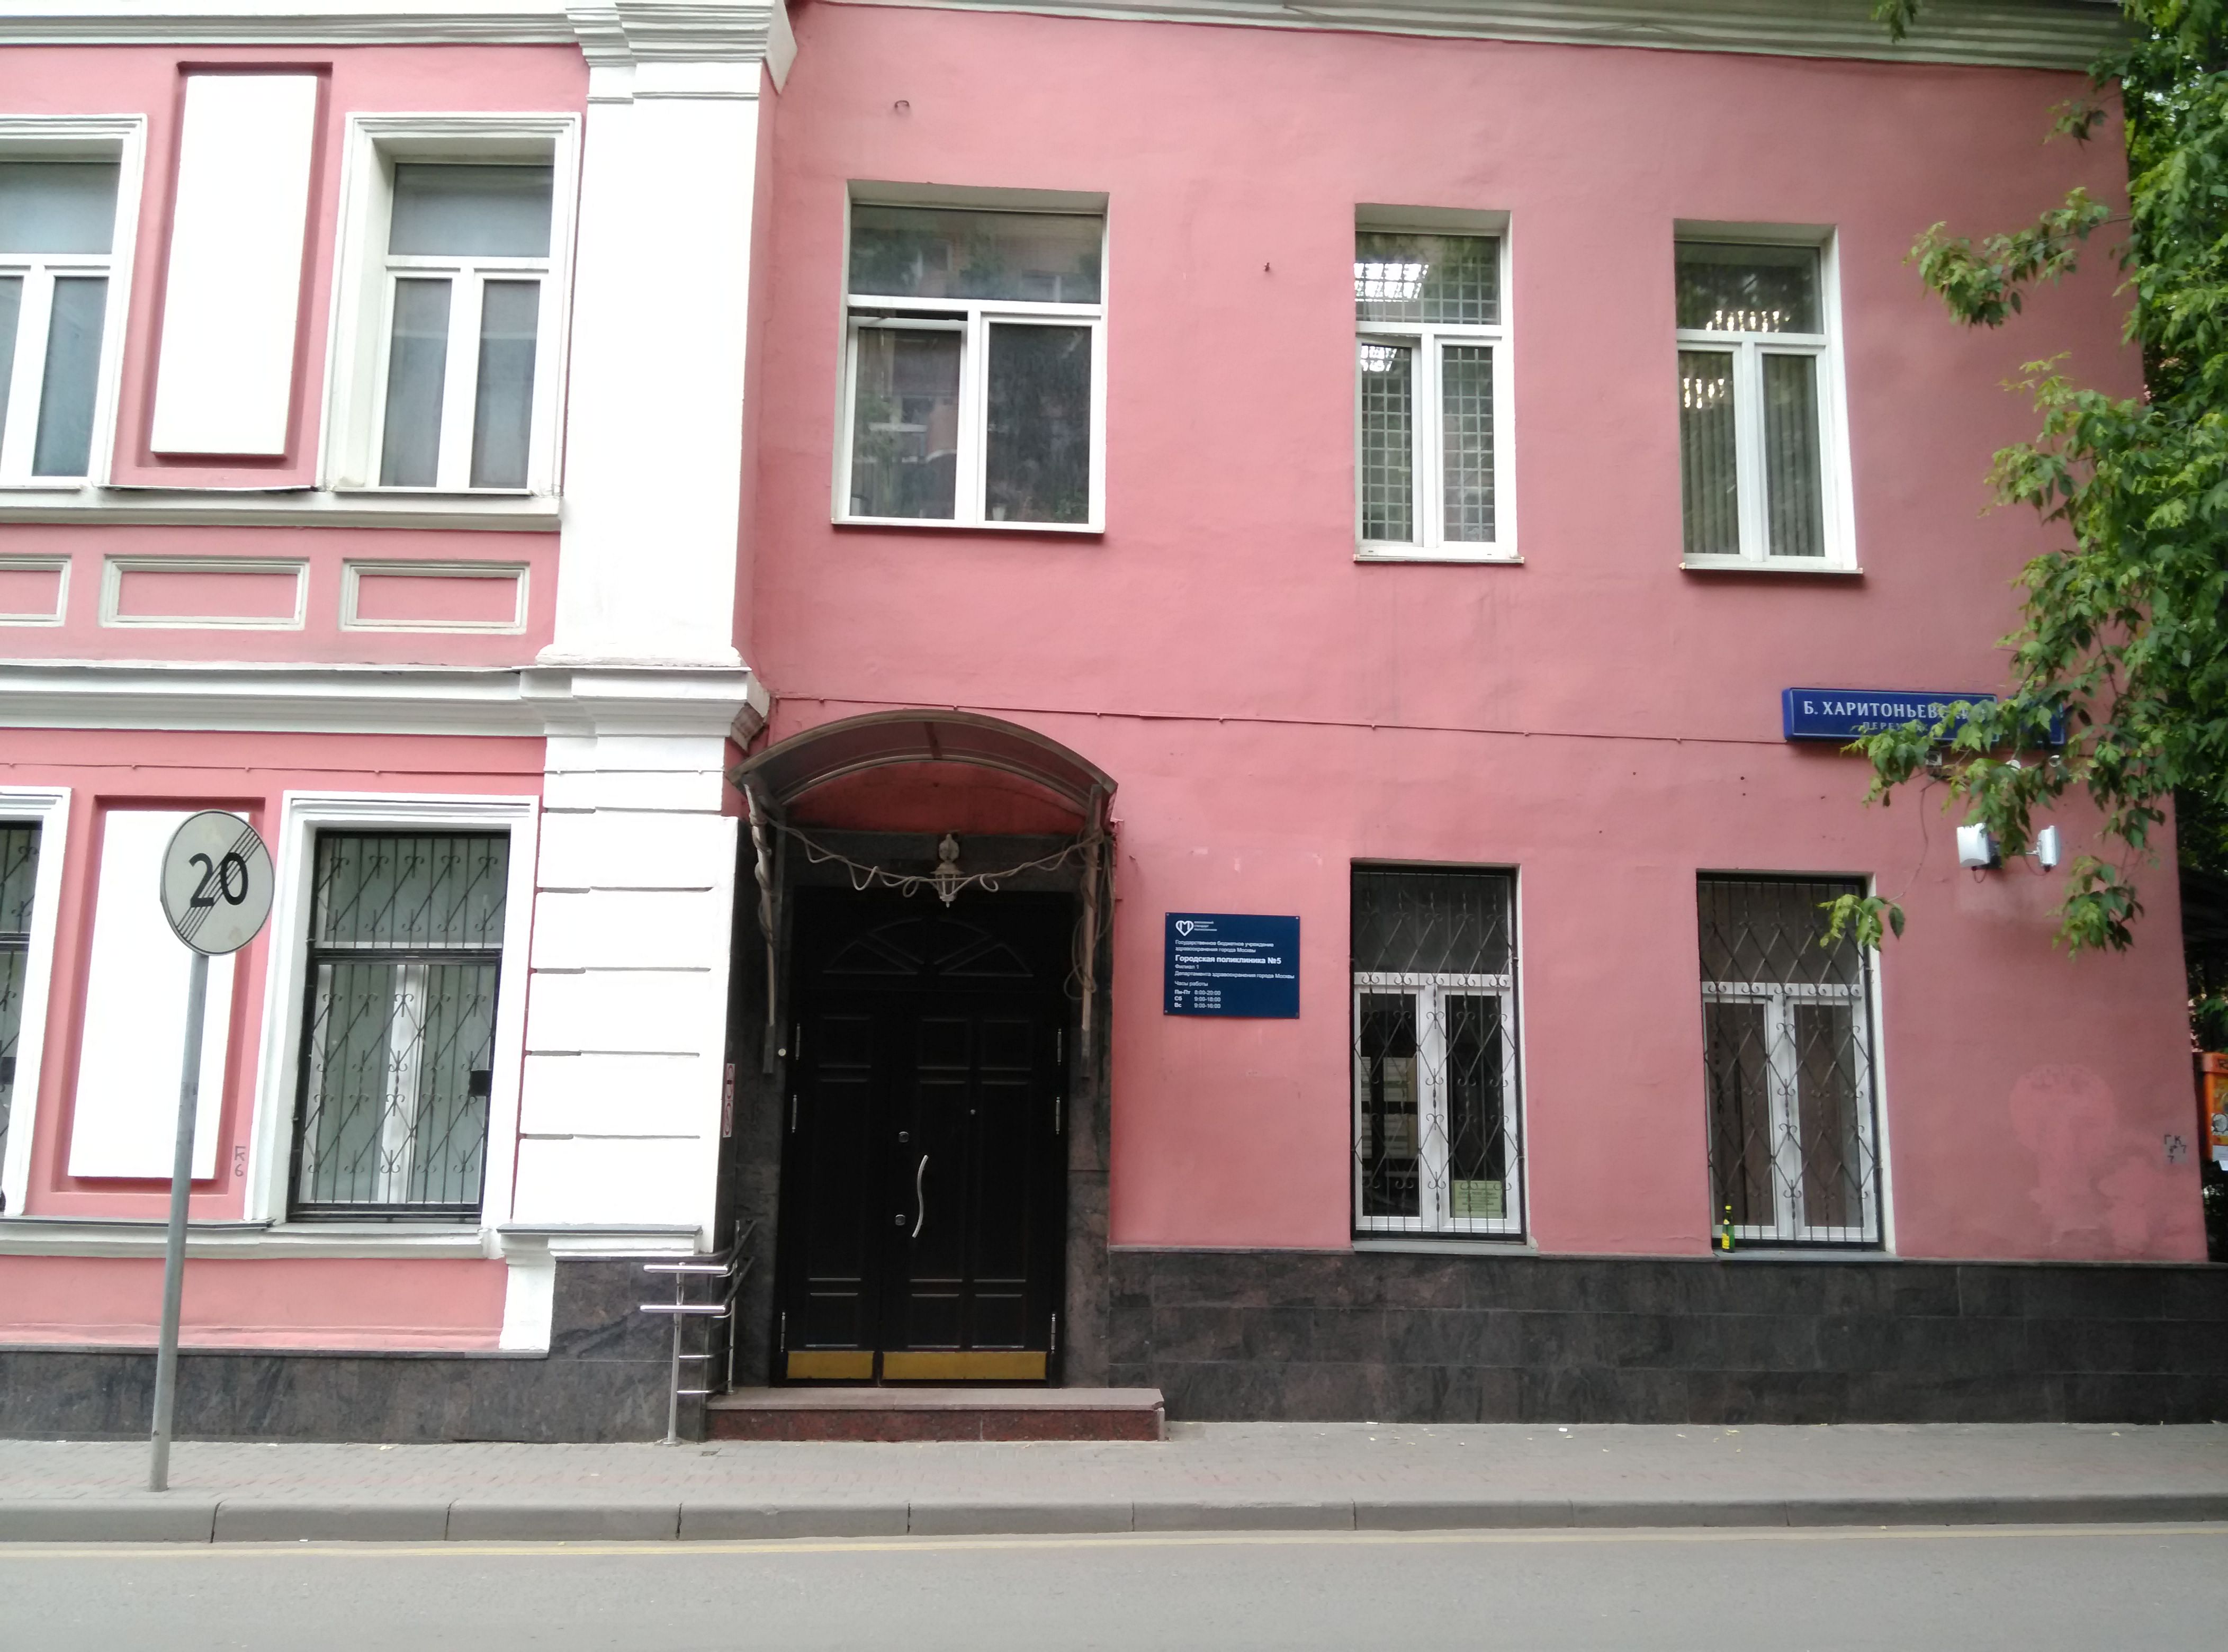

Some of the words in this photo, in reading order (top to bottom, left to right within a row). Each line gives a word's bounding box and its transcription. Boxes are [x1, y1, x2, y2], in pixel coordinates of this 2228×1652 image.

[1803, 701, 1819, 715] Б.
[188, 852, 248, 906] 20
[1175, 955, 1216, 963] Городская
